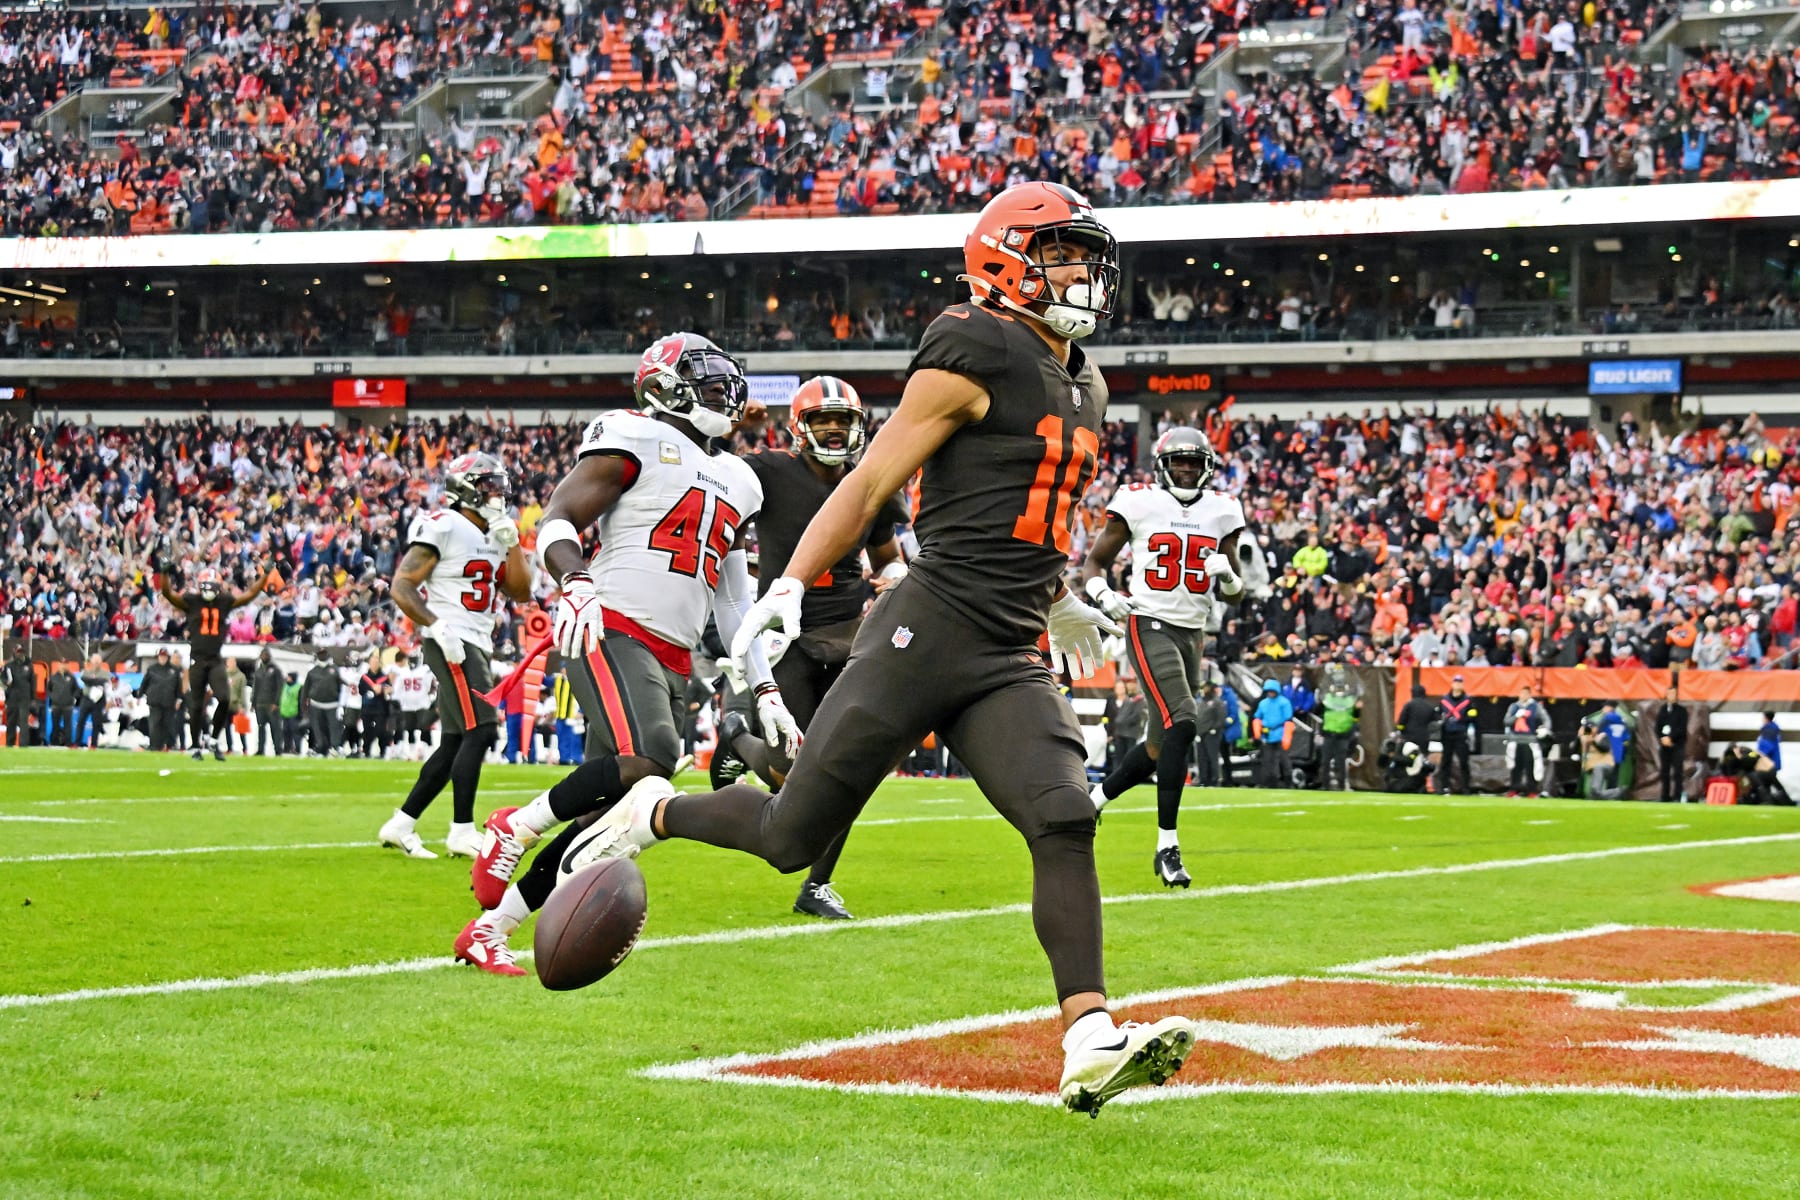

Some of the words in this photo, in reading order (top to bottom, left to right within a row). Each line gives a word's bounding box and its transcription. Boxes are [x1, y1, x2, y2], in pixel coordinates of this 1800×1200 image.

[1148, 374, 1211, 394] #give10
[1594, 370, 1626, 385] BUD
[1628, 368, 1673, 384] LIGHT
[1012, 413, 1100, 556] 10
[648, 486, 742, 592] 45
[1145, 532, 1217, 594] 35
[200, 607, 220, 636] 11
[403, 677, 423, 692] 95
[1710, 786, 1729, 804] 10
